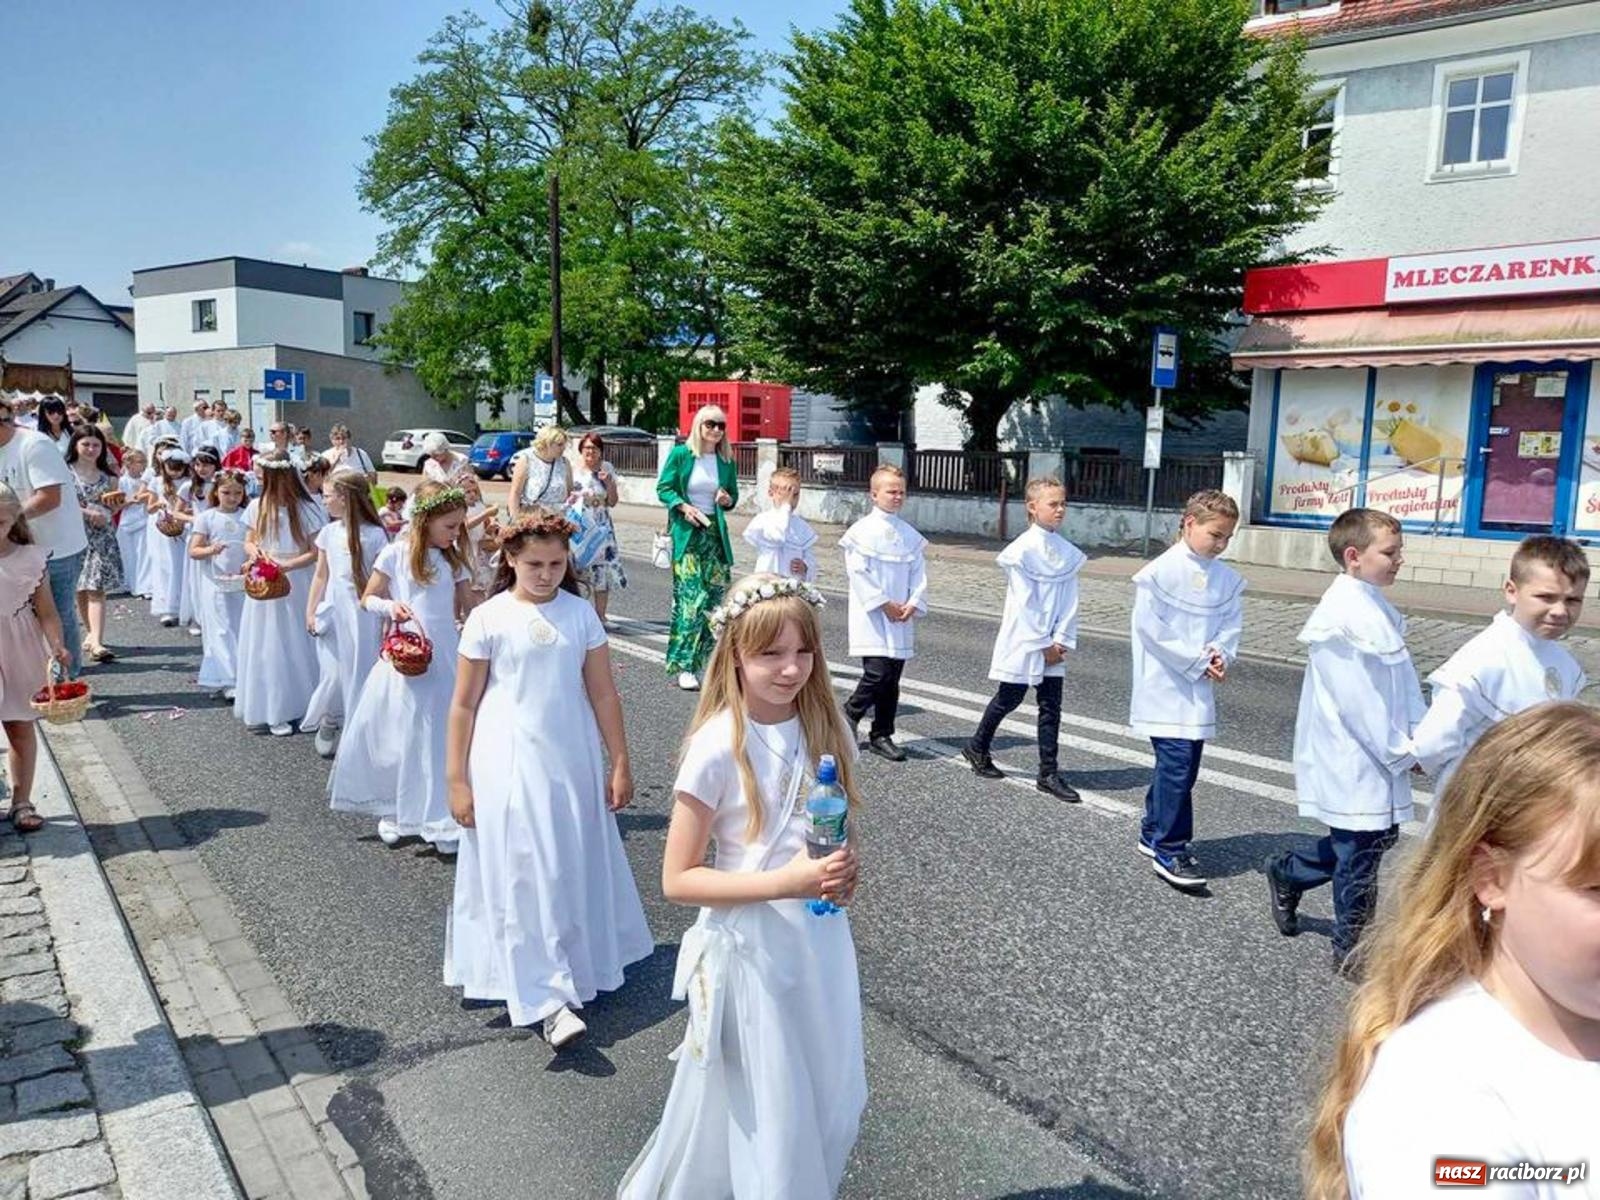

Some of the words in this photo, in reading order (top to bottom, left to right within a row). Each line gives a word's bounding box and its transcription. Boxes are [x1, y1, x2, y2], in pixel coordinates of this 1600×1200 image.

[1393, 255, 1600, 288] MLECZARENK
[541, 379, 554, 400] P
[1279, 481, 1330, 496] Produkty
[1368, 486, 1428, 502] Produkty
[1294, 495, 1324, 510] firmy
